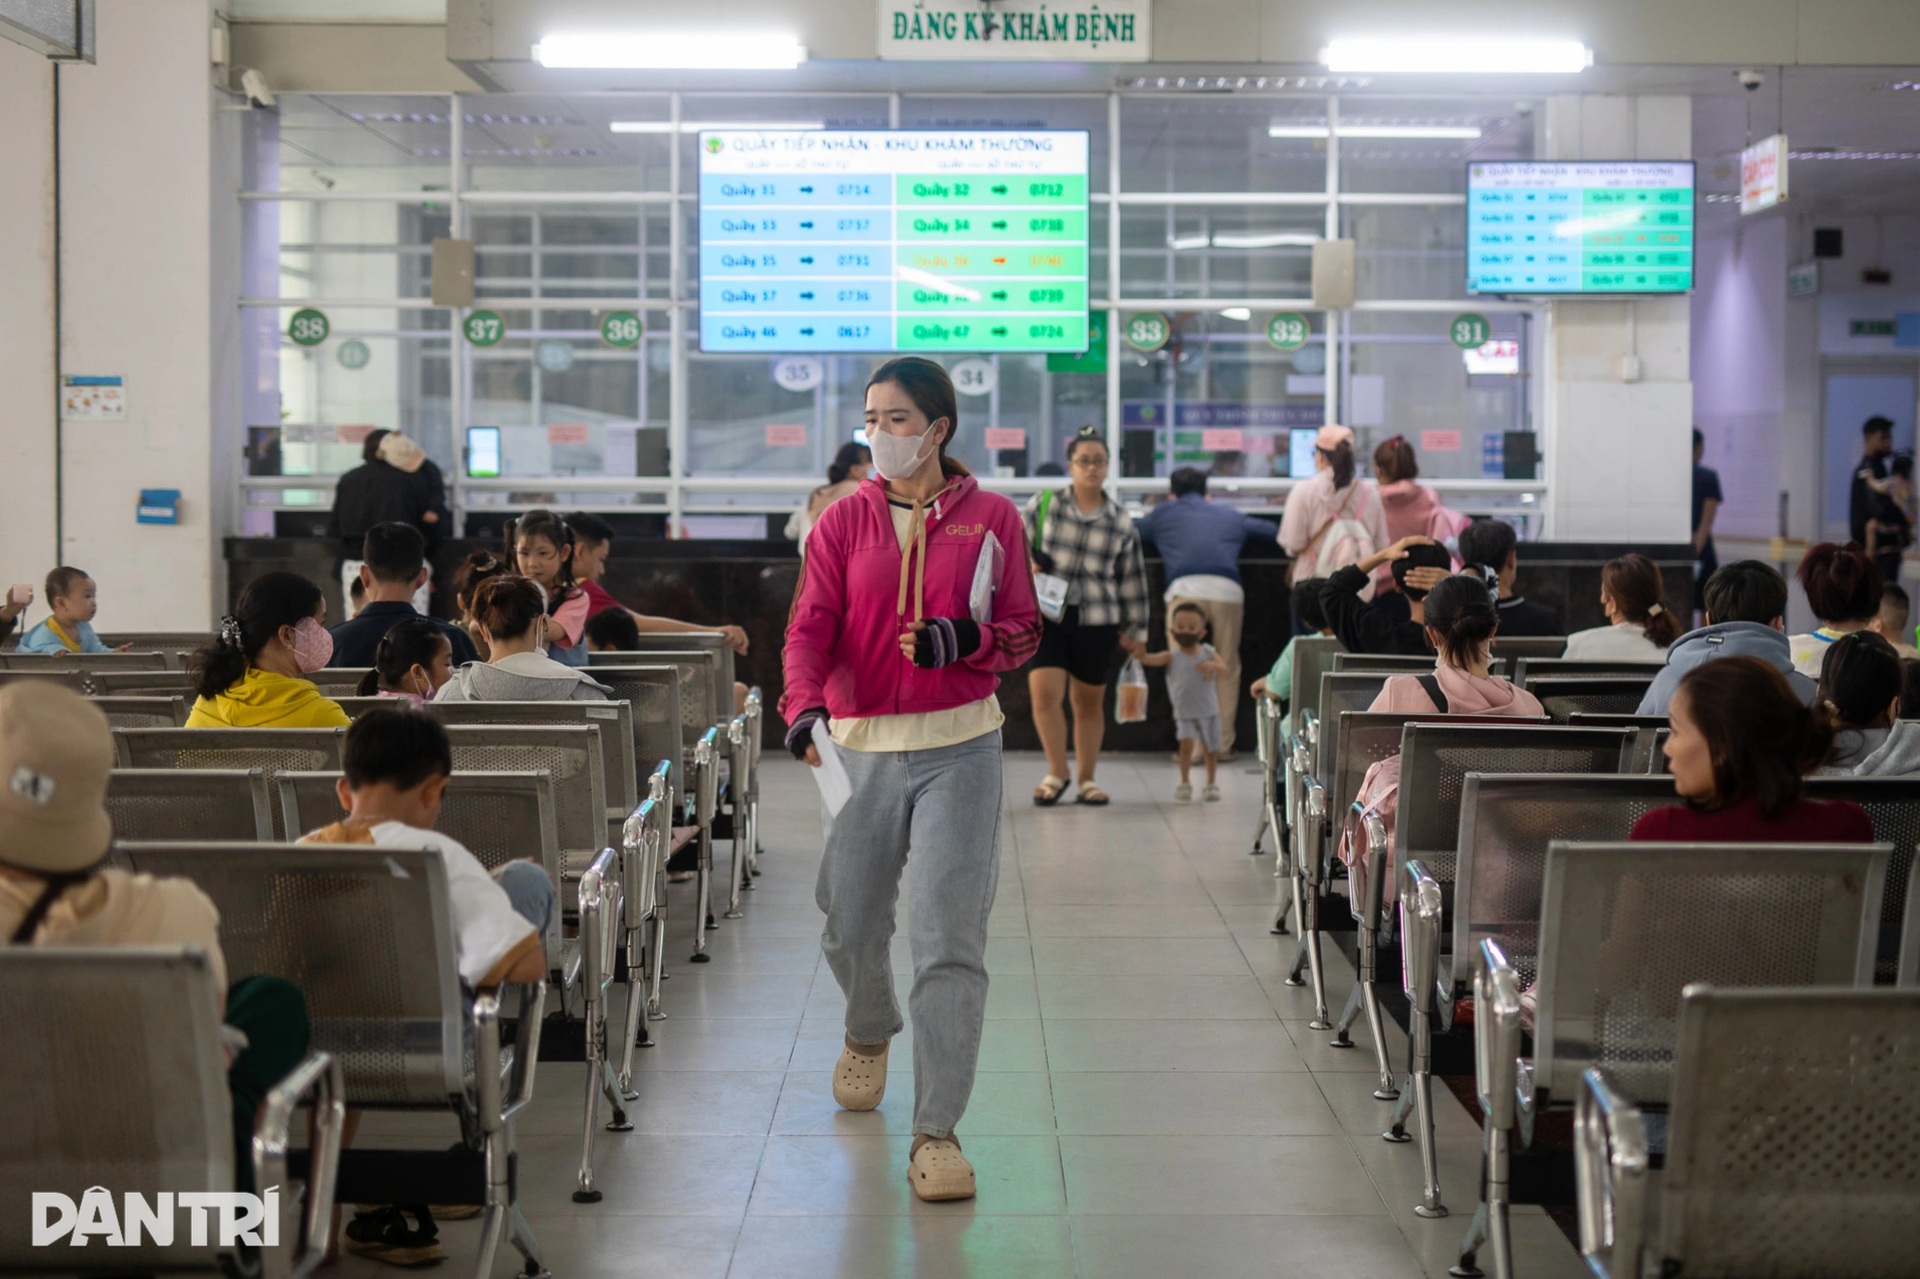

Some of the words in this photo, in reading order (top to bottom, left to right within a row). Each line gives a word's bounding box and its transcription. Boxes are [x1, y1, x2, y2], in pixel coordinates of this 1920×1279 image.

[892, 2, 958, 41] ĐĂNG
[1002, 5, 1069, 41] KHÁM
[1075, 5, 1136, 49] BỆNH
[294, 318, 324, 340] 38
[469, 318, 499, 341] 37
[607, 318, 638, 341] 36
[1132, 320, 1163, 342] 33
[1273, 320, 1304, 342] 32
[1456, 321, 1483, 343] 31
[785, 364, 810, 382] 35
[961, 368, 983, 385] 34
